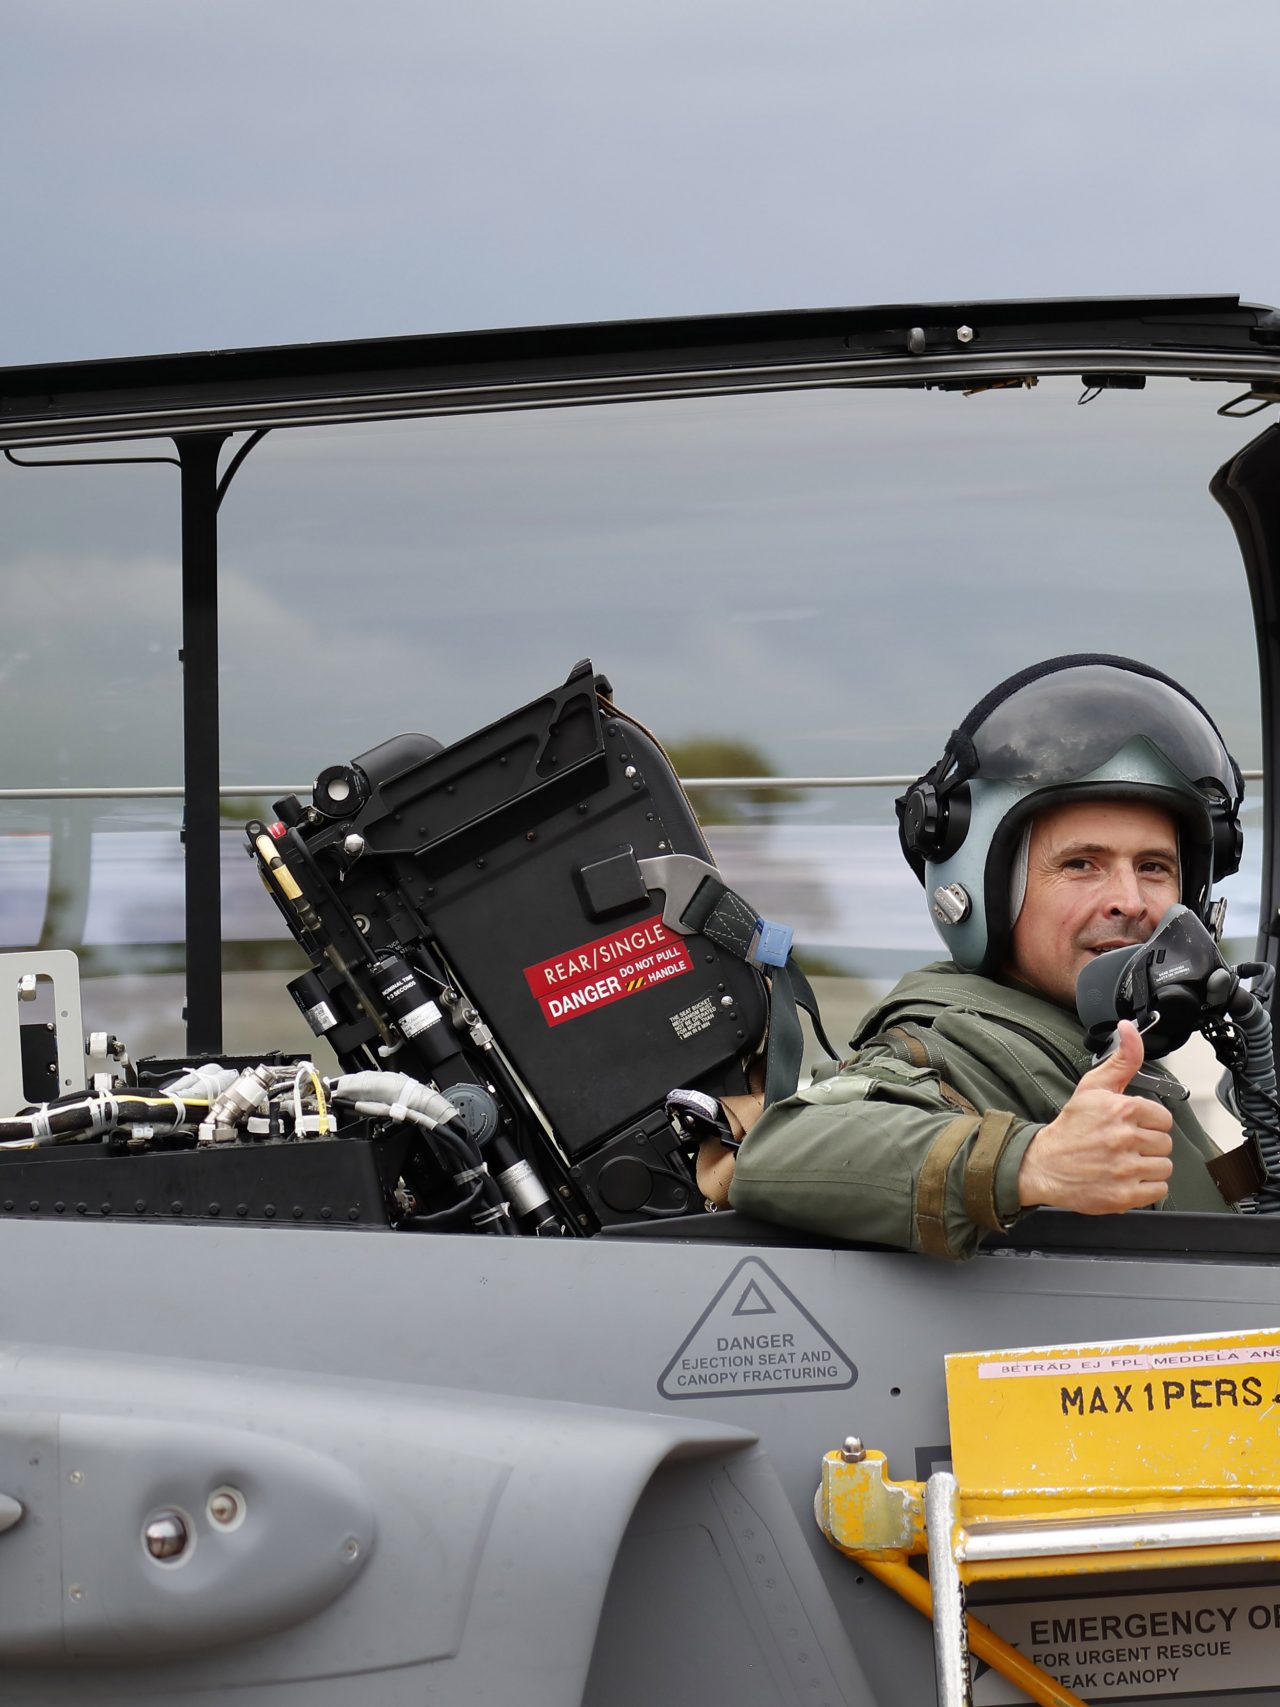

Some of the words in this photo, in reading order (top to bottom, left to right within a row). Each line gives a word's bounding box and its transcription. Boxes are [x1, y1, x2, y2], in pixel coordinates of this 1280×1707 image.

[544, 924, 665, 985] REAR/SINGLE
[619, 966, 634, 977] DO
[635, 957, 654, 971] NOT
[656, 947, 681, 963] PULL
[648, 960, 687, 983] HANDLE
[382, 981, 403, 996] NOMINAL
[394, 980, 416, 996] SECONDS
[548, 976, 622, 1018] DANGER
[669, 1014, 679, 1022] THE
[679, 1007, 691, 1017] SEAT
[717, 1334, 794, 1351] DANGER
[682, 1355, 753, 1370] EJECTION
[758, 1352, 796, 1366] SEAT
[801, 1350, 831, 1363] AND
[1081, 1361, 1101, 1370] EJ
[1111, 1358, 1144, 1368] FPL
[1153, 1352, 1239, 1365] MEDDELA
[677, 1372, 738, 1386] CANOPY
[743, 1366, 838, 1382] FRACTURING
[1030, 1607, 1238, 1645] EMERGENCY
[1033, 1653, 1071, 1668] FOR
[1076, 1647, 1151, 1666] URGENT
[1157, 1641, 1231, 1660] RESCUE
[1103, 1668, 1180, 1686] CANOPY
